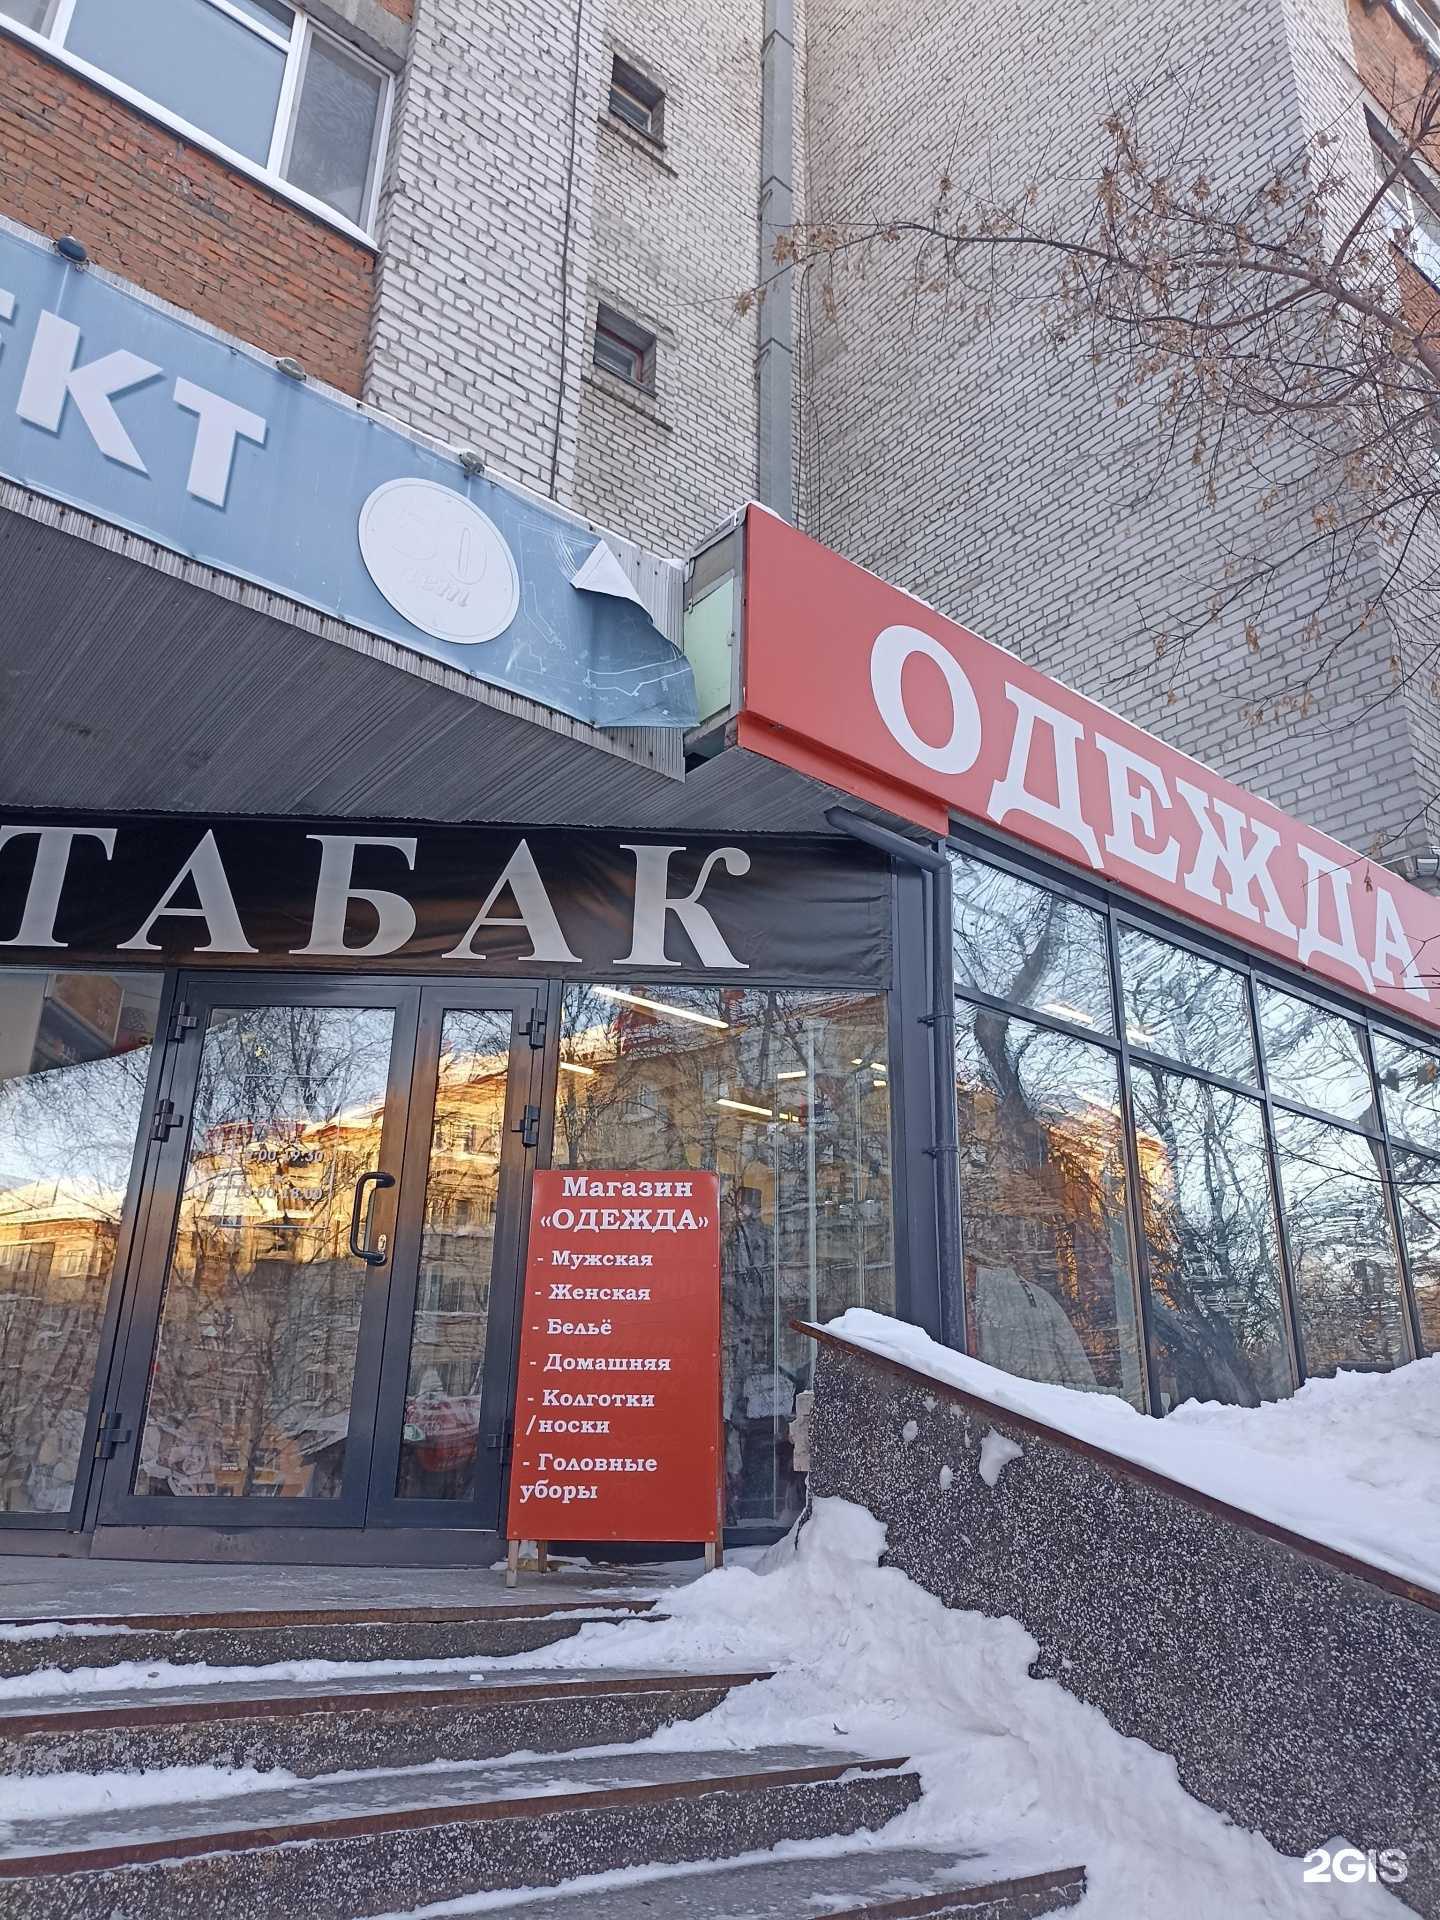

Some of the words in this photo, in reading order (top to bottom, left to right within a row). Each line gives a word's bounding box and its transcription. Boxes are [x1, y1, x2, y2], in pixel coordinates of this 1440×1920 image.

[0, 288, 266, 508] КТ
[870, 625, 1430, 1001] ОДЕЖДА
[0, 825, 751, 969] ТАБАК
[562, 1177, 692, 1196] Магазин
[541, 1209, 708, 1233] «ОДЕЖДА»
[552, 1251, 653, 1269] Мужская
[548, 1284, 650, 1302] Женская
[547, 1319, 611, 1335] Бельё
[544, 1354, 671, 1372] Домашняя
[542, 1390, 654, 1406] Колготки
[526, 1415, 609, 1435] /носки
[538, 1454, 657, 1471] Головные
[520, 1482, 597, 1503] уборы
